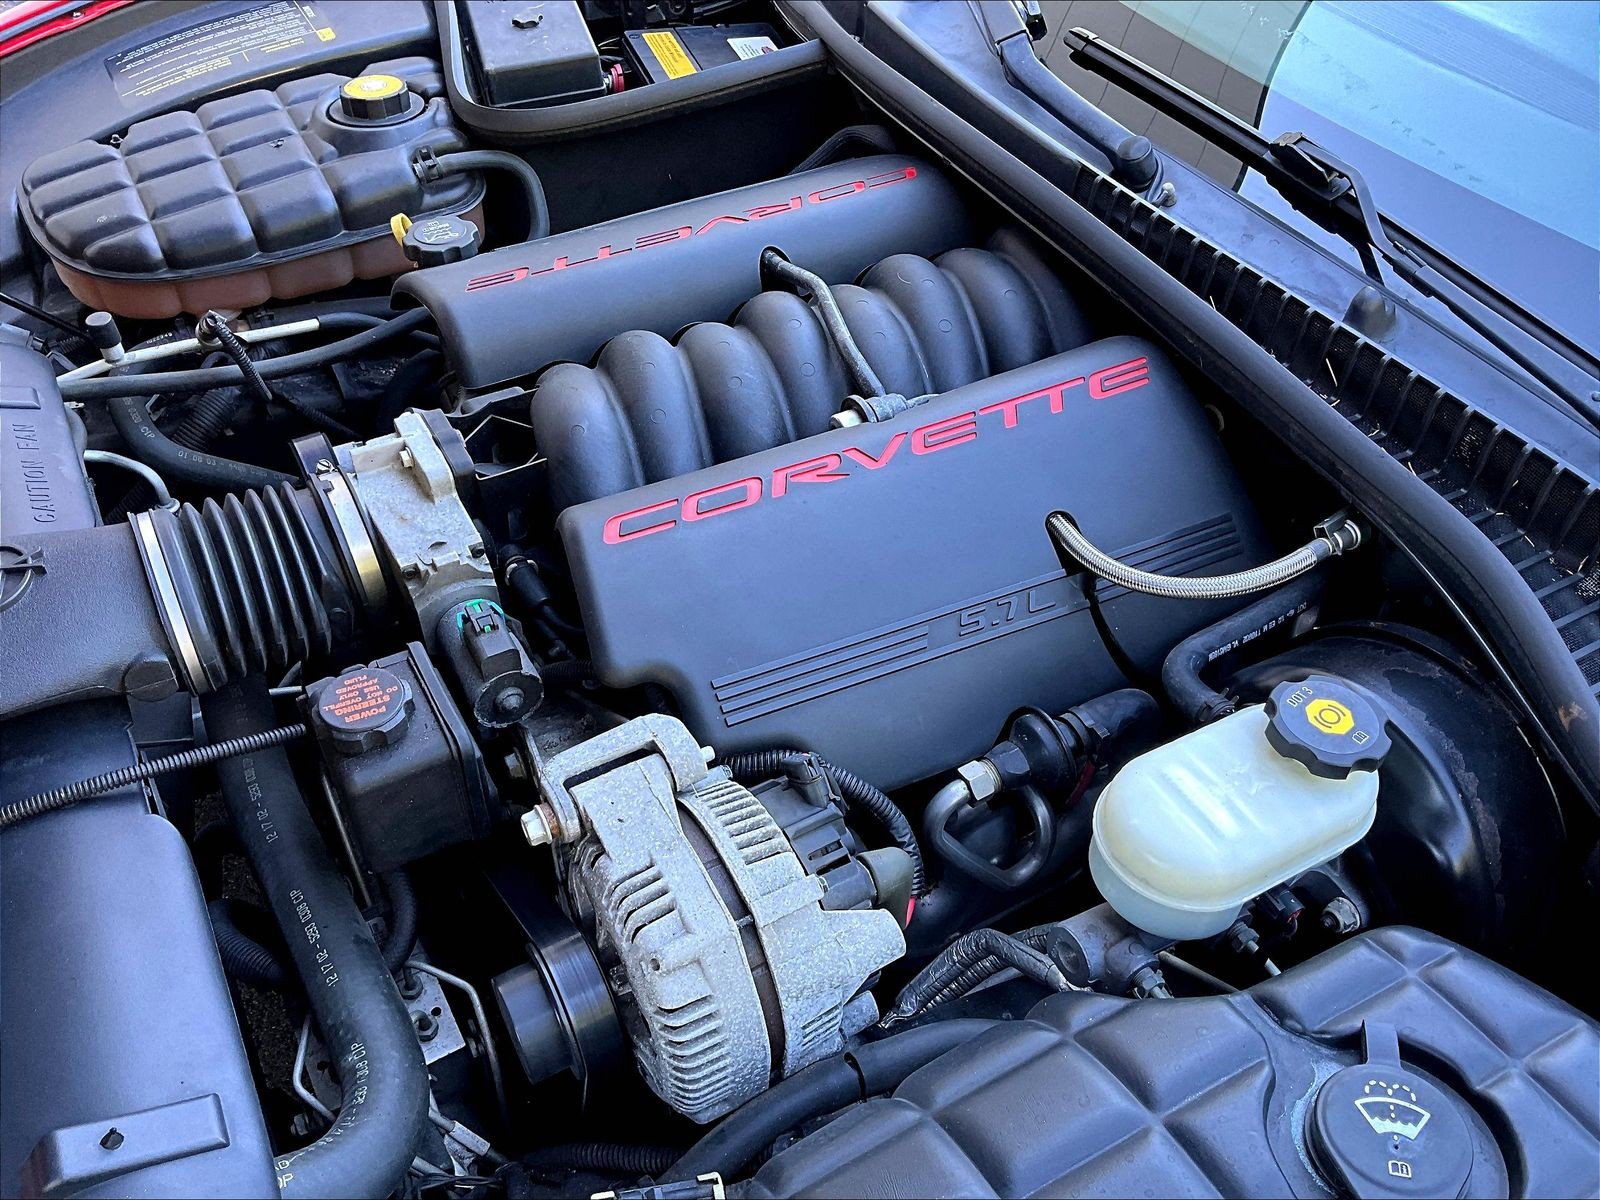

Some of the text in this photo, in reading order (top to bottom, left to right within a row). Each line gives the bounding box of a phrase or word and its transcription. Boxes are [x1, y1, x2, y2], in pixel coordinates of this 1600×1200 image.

[466, 167, 917, 292] CORVETTE
[140, 426, 157, 440] CIP
[603, 357, 1150, 544] CORVETTE
[12, 423, 57, 523] CAUTION FAN
[335, 677, 379, 695] APPROVED
[344, 674, 368, 686] FLUID
[322, 685, 399, 712] DO NOT OVERFILL
[339, 684, 381, 701] USE ONLY
[1286, 686, 1313, 708] DOT 3
[334, 694, 392, 716] STEERING
[344, 705, 387, 724] POWER
[257, 808, 269, 821] 02
[261, 821, 274, 832] 17
[266, 831, 279, 844] 12
[289, 889, 304, 904] CIP
[296, 902, 312, 923] 0308
[304, 922, 321, 944] 5293
[316, 949, 329, 963] 02
[320, 962, 334, 975] 17
[350, 1042, 366, 1060] CIP
